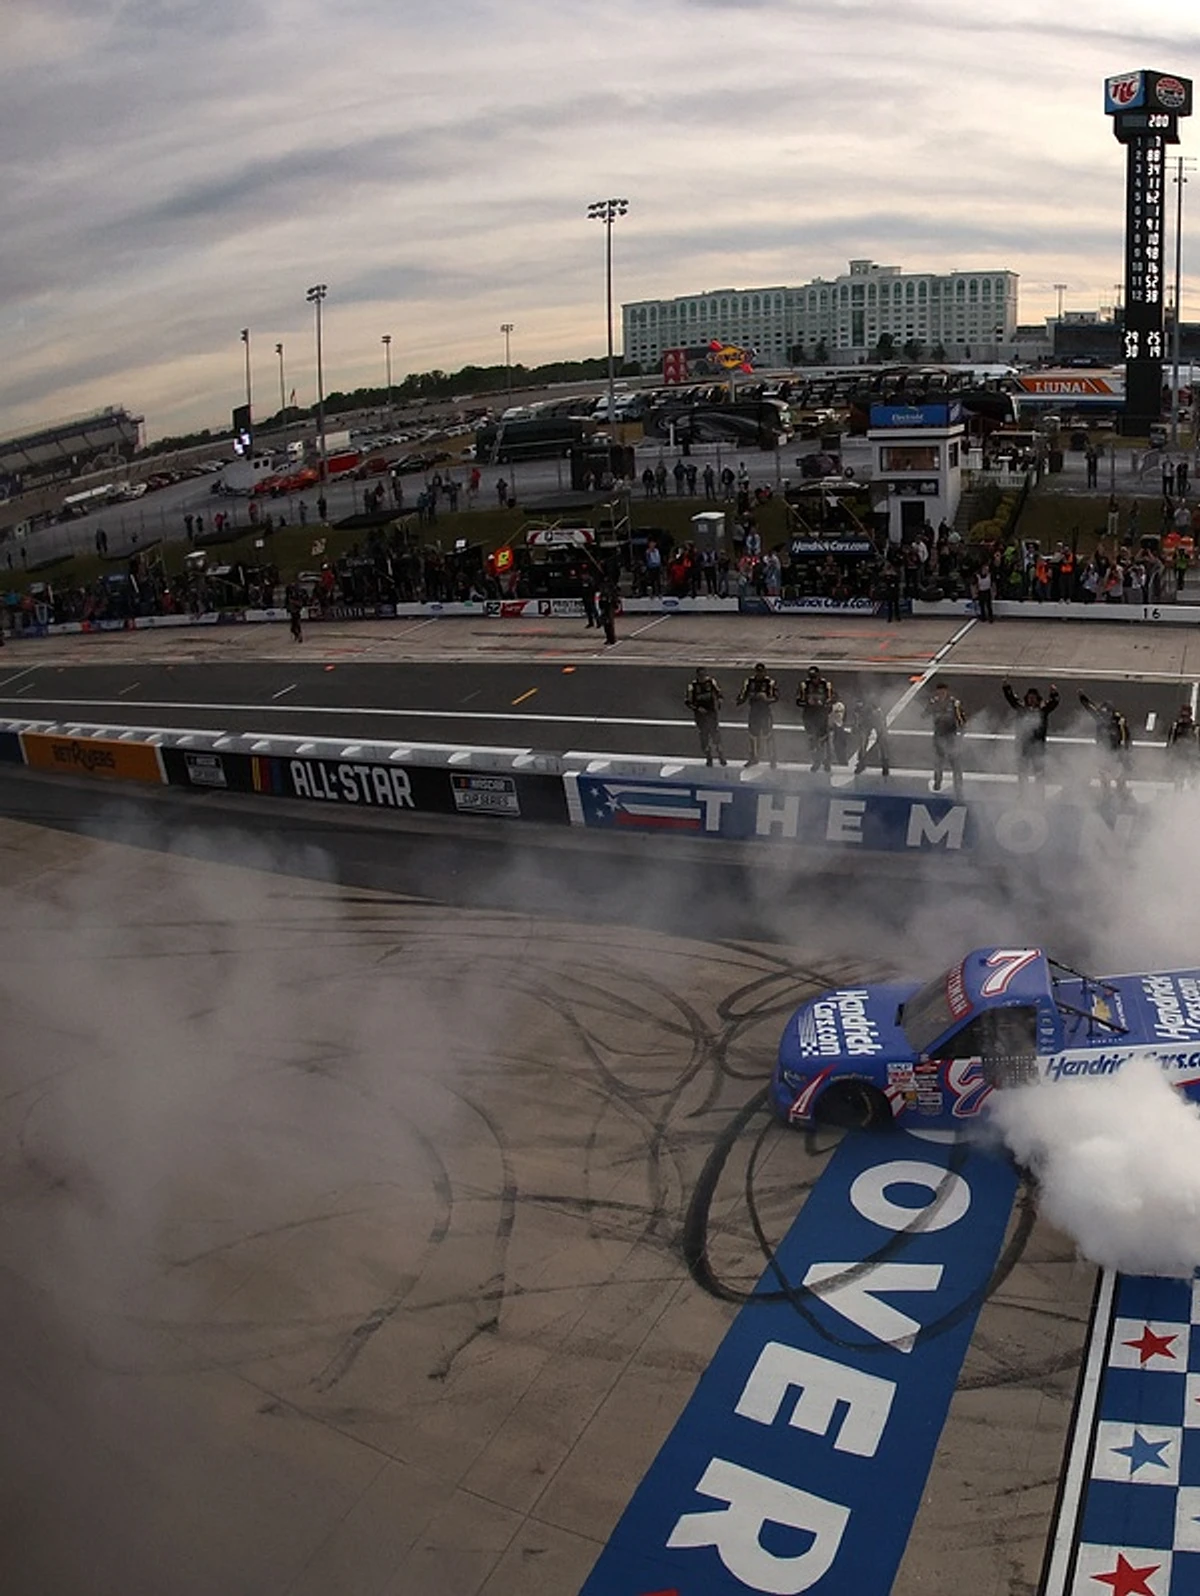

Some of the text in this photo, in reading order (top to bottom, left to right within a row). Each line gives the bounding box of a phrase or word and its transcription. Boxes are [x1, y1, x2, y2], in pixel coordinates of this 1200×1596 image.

[1148, 114, 1168, 128] 200
[1149, 178, 1160, 189] 11
[1146, 275, 1159, 289] 52
[1147, 331, 1161, 346] 25
[1143, 608, 1161, 619] 16
[695, 790, 866, 843] THE
[981, 949, 1041, 997] 7
[826, 990, 883, 1055] Hendrick
[1142, 975, 1199, 1040] Hendrick
[814, 1002, 841, 1056] Cars.com
